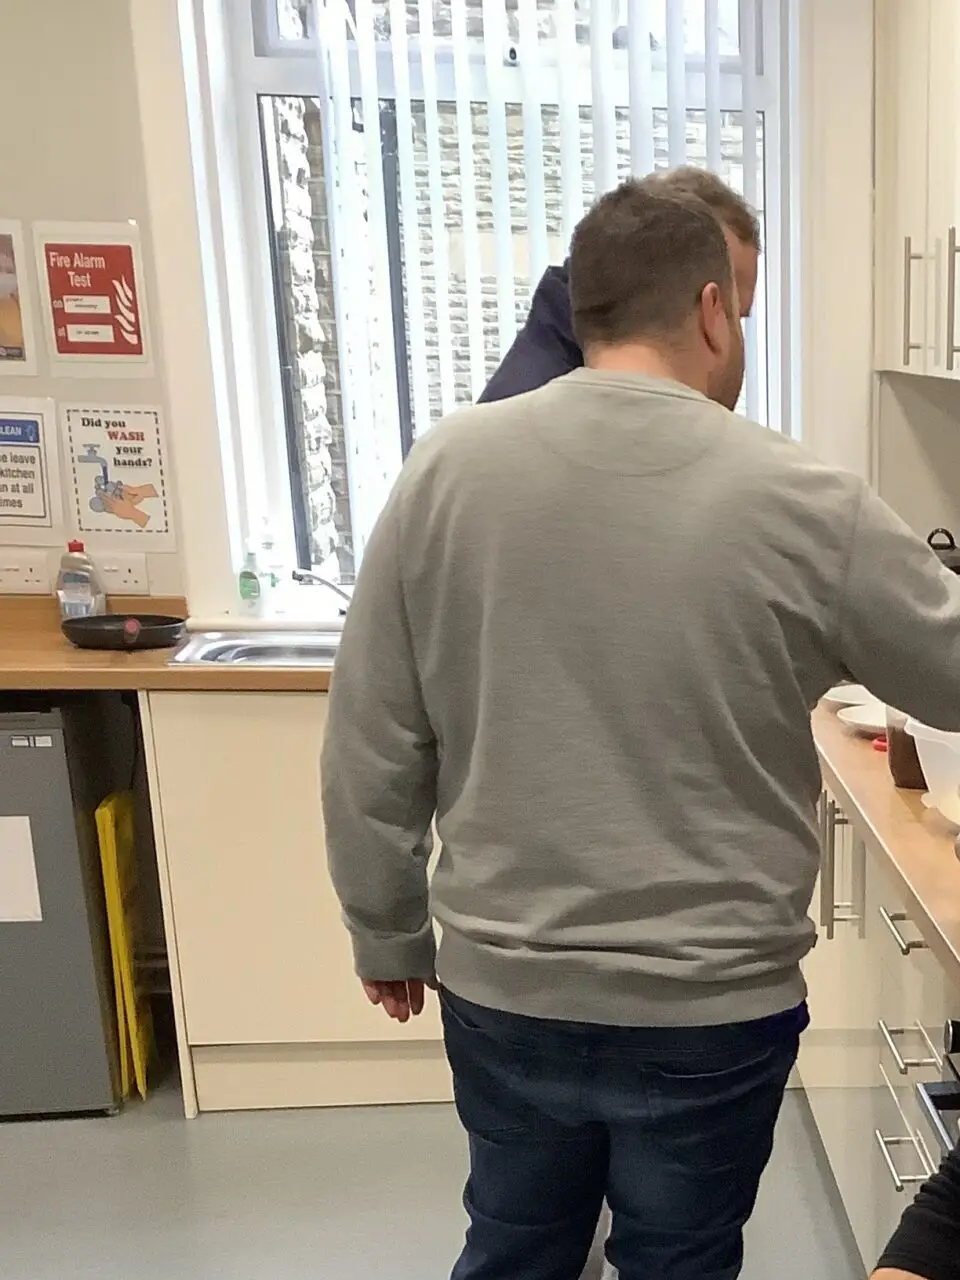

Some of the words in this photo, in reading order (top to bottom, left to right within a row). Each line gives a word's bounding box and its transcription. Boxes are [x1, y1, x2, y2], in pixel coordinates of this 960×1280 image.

[49, 251, 71, 268] Fire
[73, 252, 105, 269] Alarm
[67, 271, 91, 288] Test
[81, 417, 102, 428] Did
[104, 420, 126, 429] you
[0, 425, 22, 436] LEAN
[107, 430, 145, 442] WASH
[115, 446, 144, 455] your
[10, 451, 36, 465] leave
[113, 457, 153, 468] hands?
[0, 467, 35, 479] kitchen
[10, 482, 20, 493] at
[22, 482, 35, 494] all
